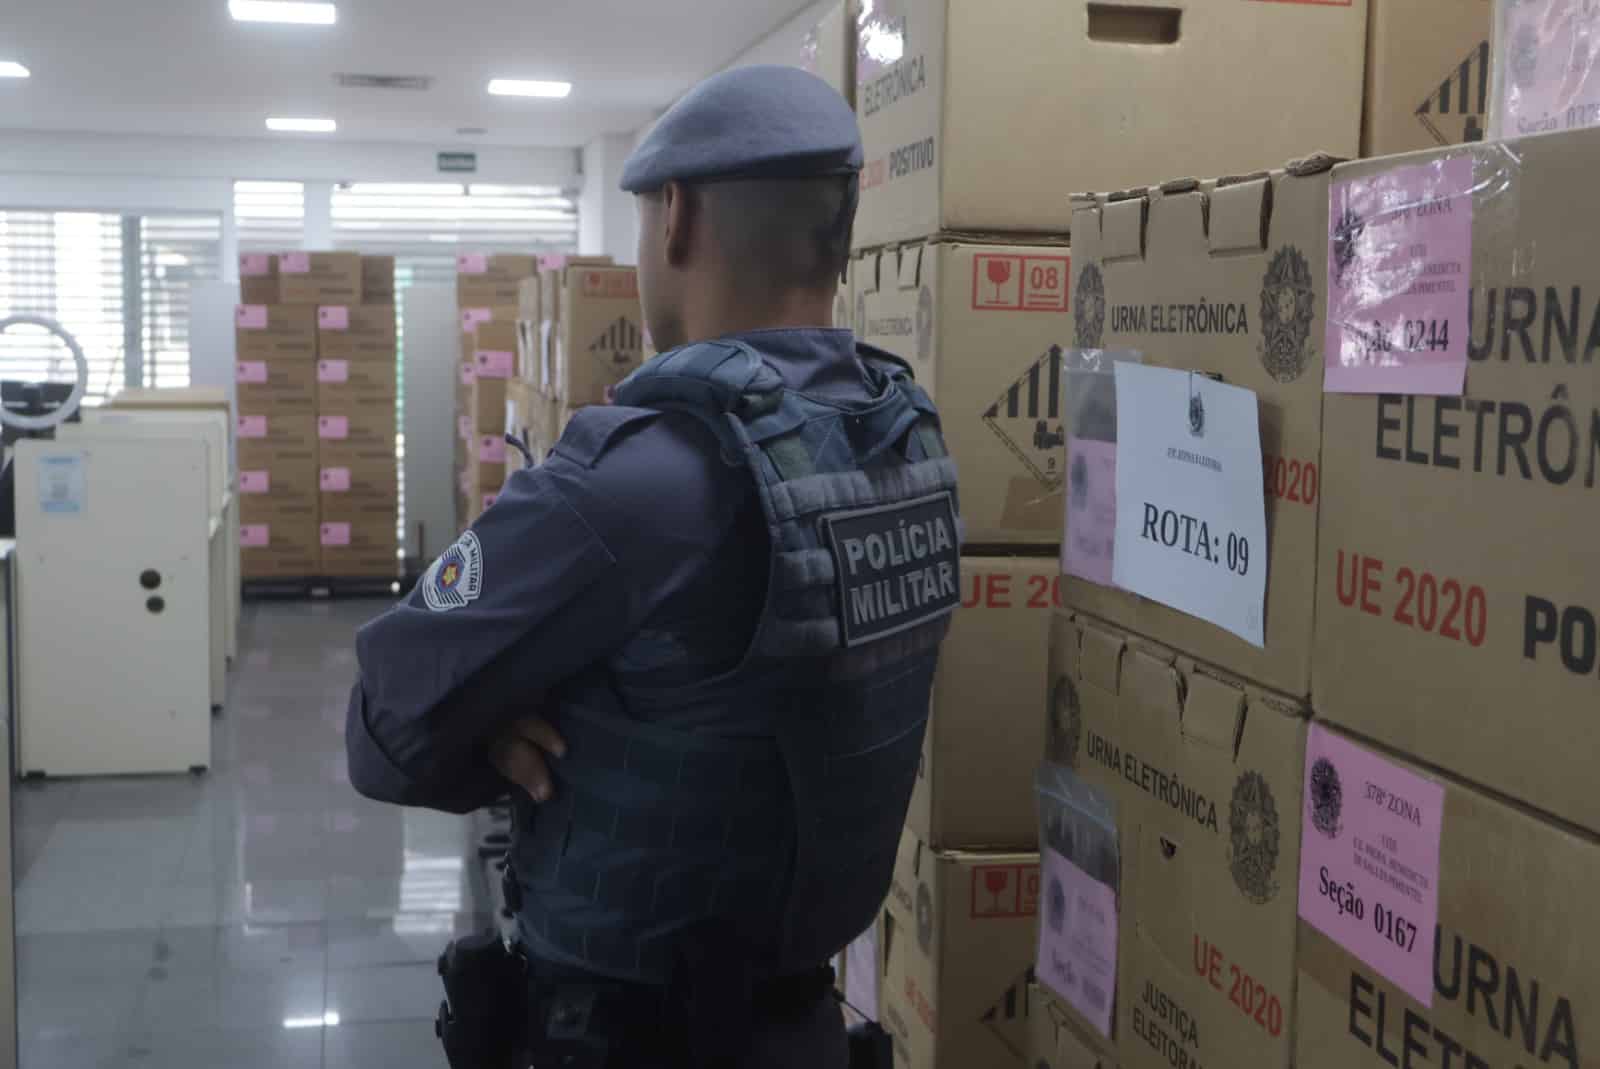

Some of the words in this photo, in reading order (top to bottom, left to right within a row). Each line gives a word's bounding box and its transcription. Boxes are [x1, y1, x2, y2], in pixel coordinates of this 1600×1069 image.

[1031, 266, 1059, 290] 08
[1111, 305, 1147, 333] URNA
[1151, 297, 1248, 334] ELETRÔNICA
[469, 547, 479, 592] MILITAR
[843, 517, 952, 575] POLÍCIA
[1141, 502, 1220, 565] ROTA:
[1227, 531, 1249, 577] 09
[850, 560, 956, 625] MILITAR
[1336, 548, 1384, 617] UE
[1393, 566, 1488, 648] 2020
[1523, 594, 1600, 681] PO
[1087, 730, 1122, 776] URNA
[1125, 754, 1219, 833] ELETRÔNICA
[1388, 792, 1422, 828] ZONA
[1319, 865, 1365, 921] Seção
[1374, 902, 1418, 953] 0167
[1193, 933, 1225, 994] UE
[1228, 962, 1283, 1038] 2020
[1350, 971, 1515, 1069] ELET
[1433, 922, 1582, 1069] URNA
